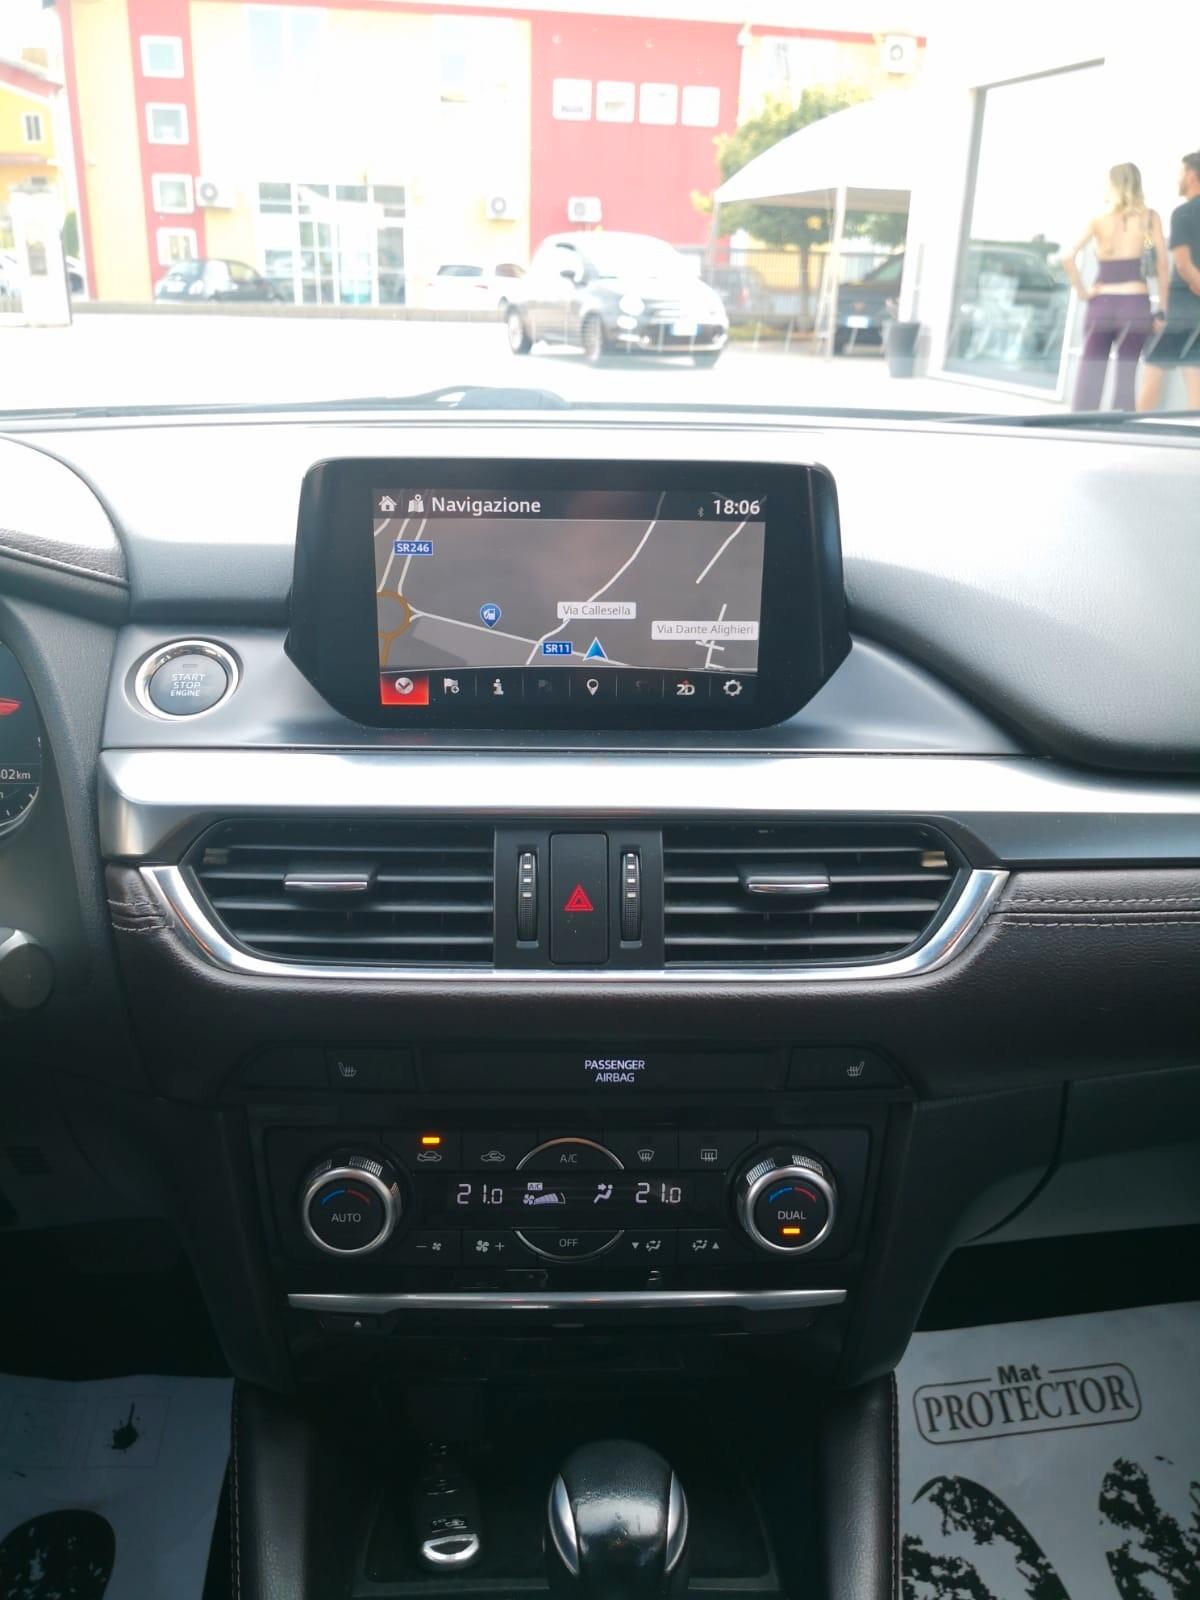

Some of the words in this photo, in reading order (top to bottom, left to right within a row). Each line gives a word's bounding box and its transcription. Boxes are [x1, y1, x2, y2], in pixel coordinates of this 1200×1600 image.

[431, 497, 541, 516] Navigazione
[713, 500, 760, 515] 18:06
[396, 542, 430, 553] SR246
[562, 605, 579, 615] Via
[581, 605, 631, 615] Callesella
[656, 624, 674, 634] Via
[675, 624, 708, 634] Dante
[710, 624, 754, 636] Alighieri
[545, 643, 570, 653] SR11
[171, 673, 205, 681] START
[173, 681, 201, 689] STOP
[676, 684, 695, 695] 2D
[584, 1060, 645, 1071] PASSENGER
[595, 1072, 636, 1083] AIRBAG
[559, 1153, 578, 1164] A/C
[456, 1183, 503, 1205] 21.0
[635, 1182, 682, 1204] 21.0
[331, 1212, 361, 1223] AUTO
[777, 1210, 807, 1221] DUAL
[559, 1238, 578, 1248] OFF
[997, 1364, 1041, 1385] Mat
[922, 1375, 1134, 1433] PROTECTOR
